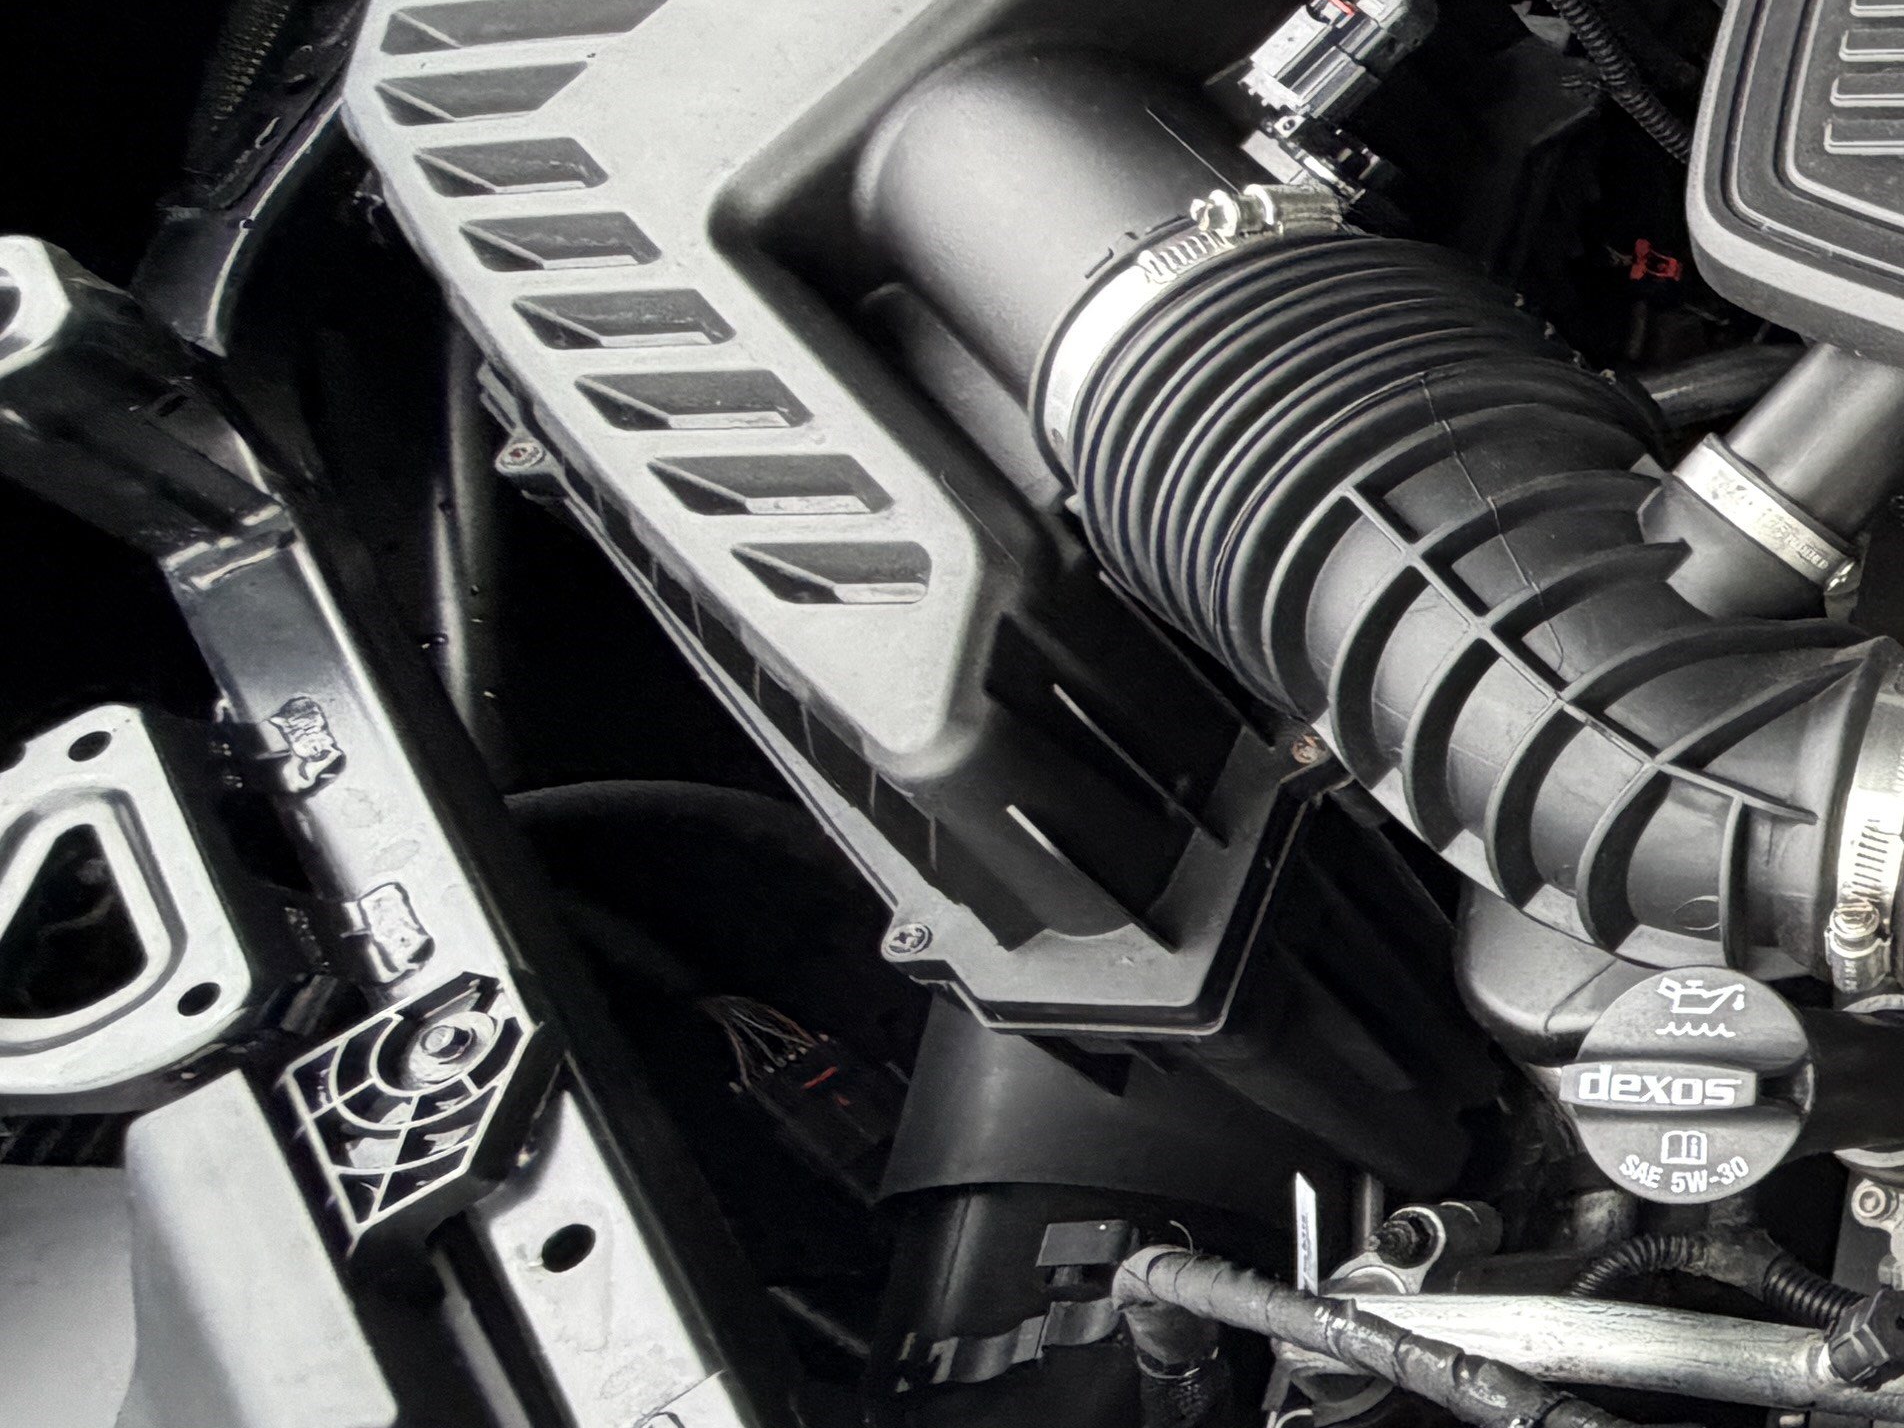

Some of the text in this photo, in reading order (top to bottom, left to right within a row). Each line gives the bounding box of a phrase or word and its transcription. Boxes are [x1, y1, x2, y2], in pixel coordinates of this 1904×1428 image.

[1577, 1064, 1743, 1106] dexos
[1618, 1154, 1751, 1194] SAE 5W-30
